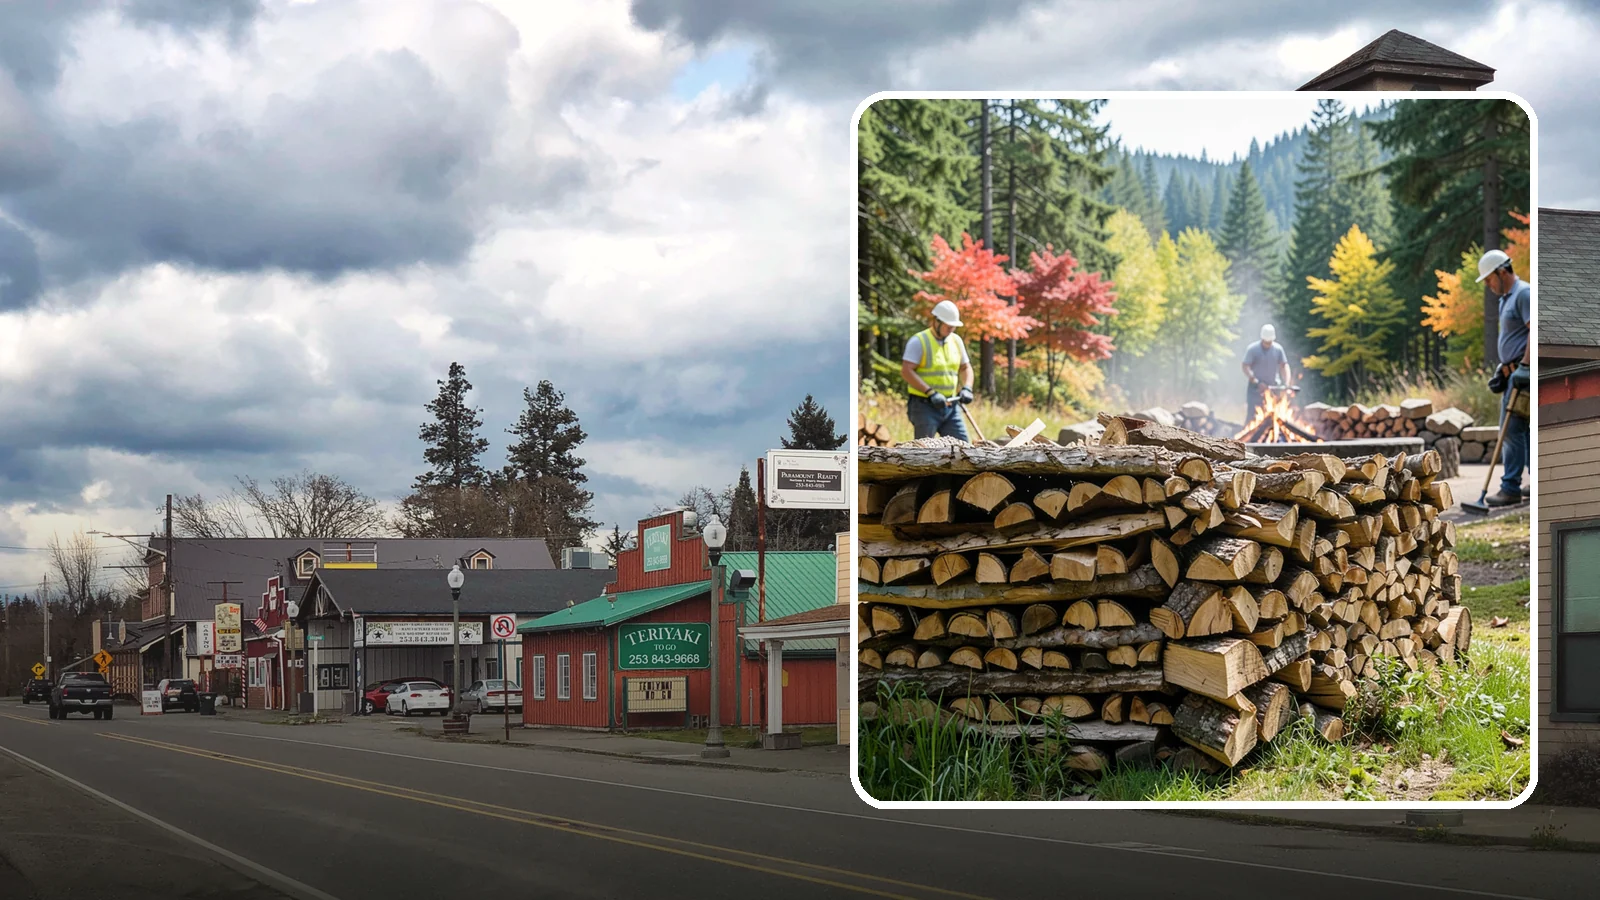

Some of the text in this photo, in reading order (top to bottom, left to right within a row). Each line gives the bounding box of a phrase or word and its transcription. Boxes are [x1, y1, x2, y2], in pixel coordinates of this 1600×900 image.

[625, 627, 702, 646] TERIYAKI
[629, 654, 700, 664] 253 843-9668
